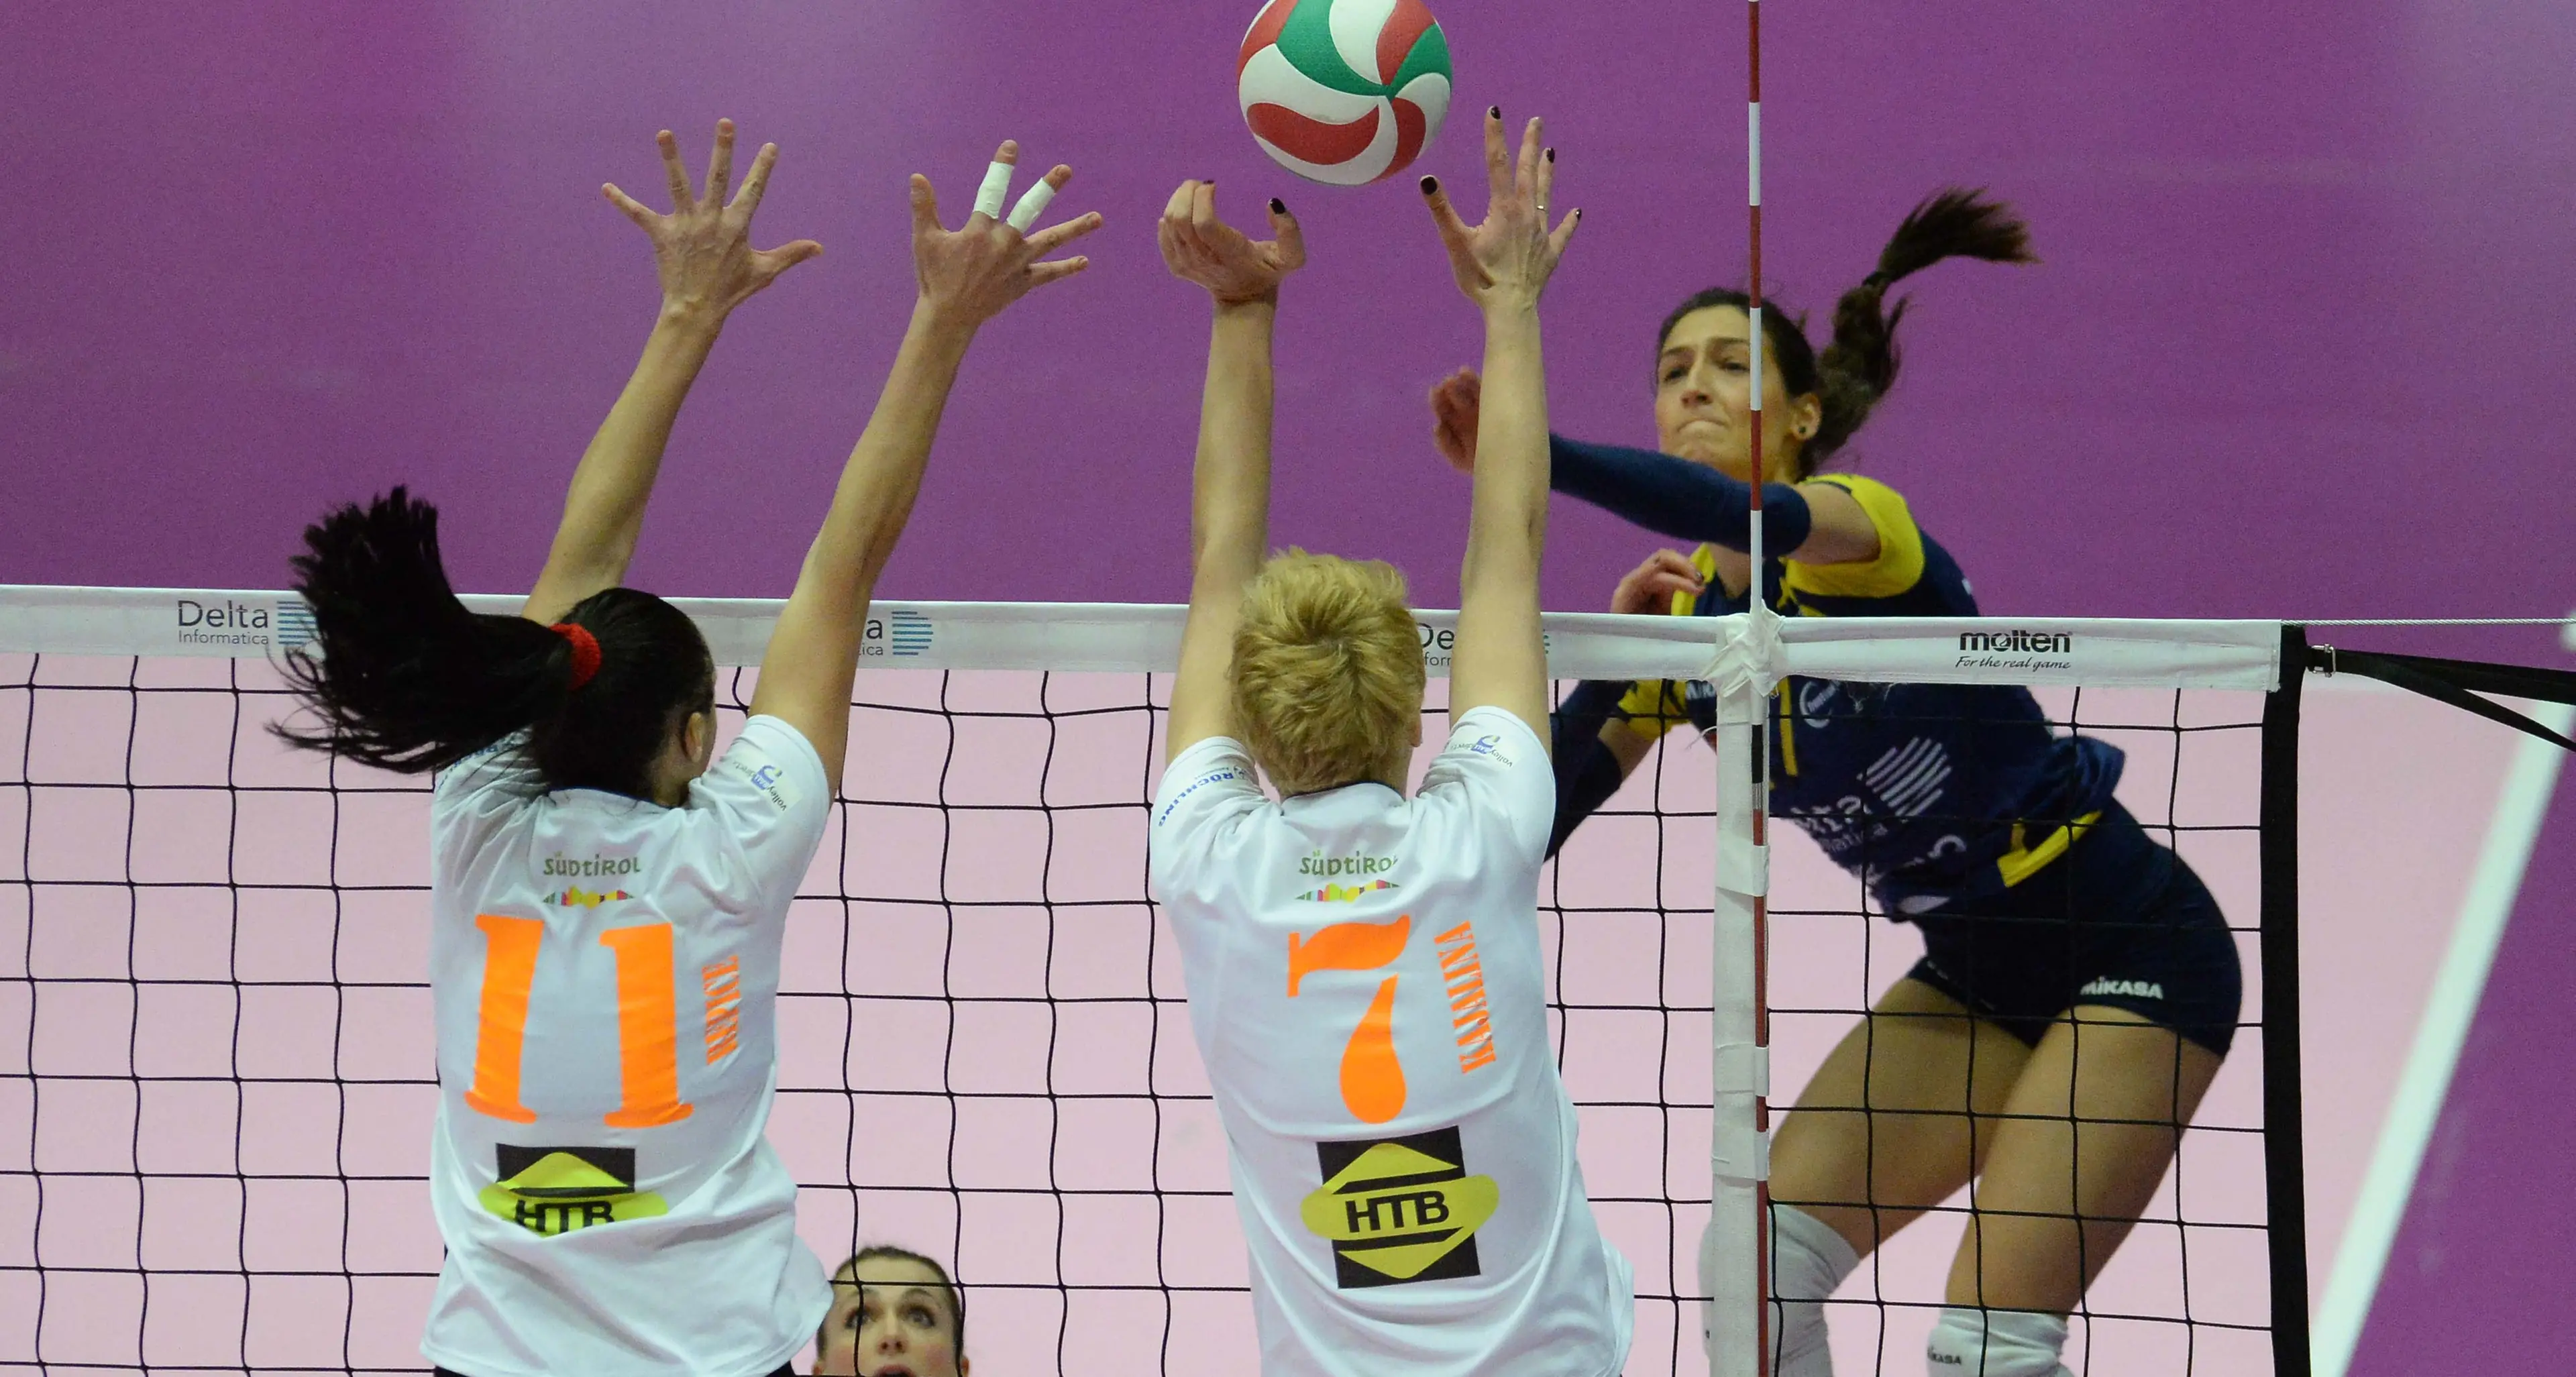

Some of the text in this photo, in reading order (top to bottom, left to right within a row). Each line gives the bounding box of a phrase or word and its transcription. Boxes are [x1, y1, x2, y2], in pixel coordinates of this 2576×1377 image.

[178, 600, 268, 628] Delta
[178, 628, 268, 645] Informatica
[1960, 630, 2070, 653] molten
[1955, 656, 2071, 672] For the real game
[464, 914, 695, 1128] 11
[1287, 914, 1410, 1125] 7
[1345, 1190, 1450, 1233] HTB
